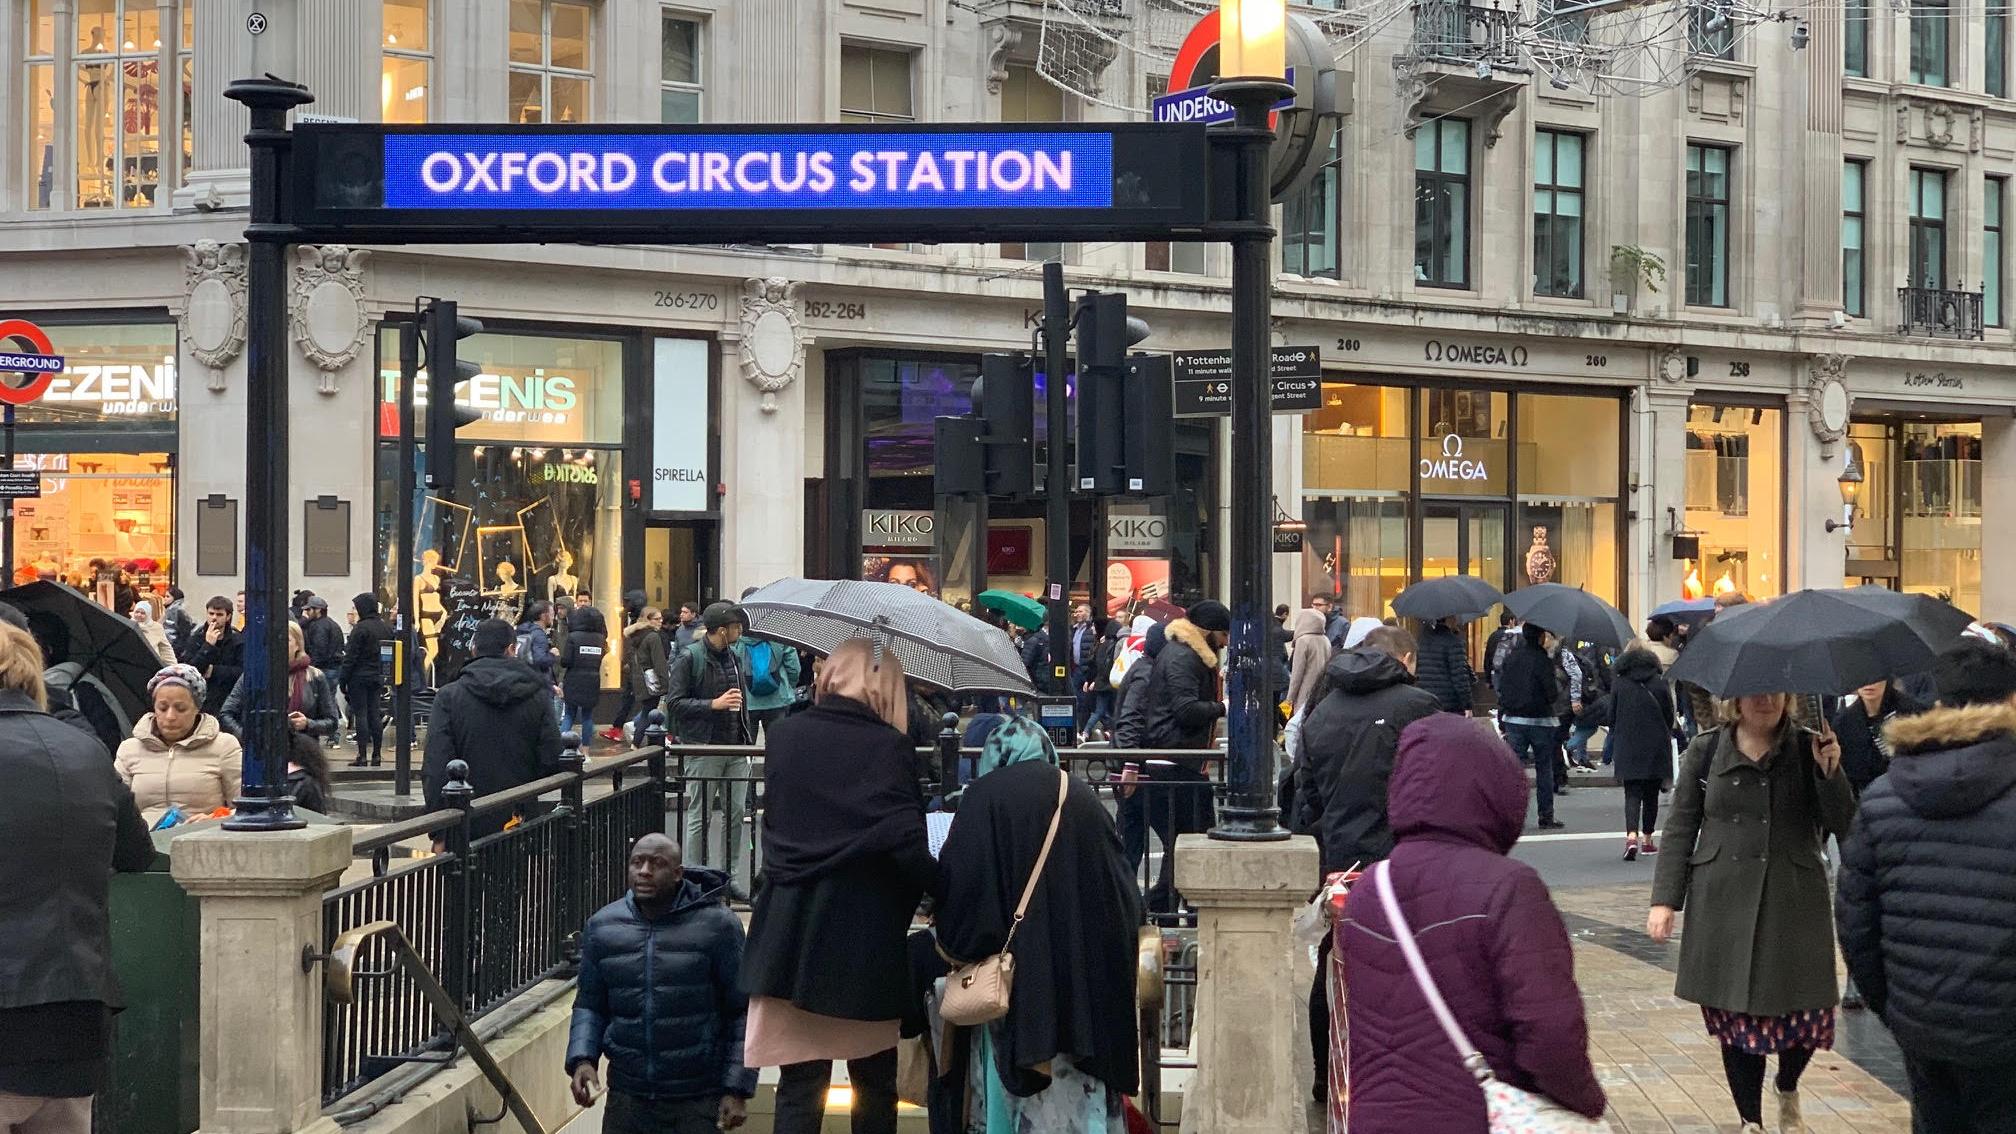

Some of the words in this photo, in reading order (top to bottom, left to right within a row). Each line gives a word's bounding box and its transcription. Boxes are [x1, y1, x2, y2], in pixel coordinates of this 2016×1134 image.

[1158, 95, 1235, 122] UNDERG
[421, 151, 637, 193] OXFORD
[651, 151, 835, 193] CIRCUS
[849, 150, 1072, 192] STATION
[654, 291, 717, 310] 266-270
[804, 300, 865, 319] 262-264
[1337, 338, 1360, 351] 260
[1446, 344, 1507, 364] OMEGA
[1186, 355, 1232, 365] Tottenha
[1272, 353, 1296, 362] Road
[1586, 355, 1607, 367] 260
[1729, 361, 1750, 377] 258
[1277, 381, 1307, 390] Circus
[655, 468, 705, 481] SPIRELLA
[1420, 458, 1488, 480] OMEGA
[869, 514, 933, 534] KIKO
[1108, 519, 1165, 538] KIKO
[1274, 532, 1300, 543] KIKO
